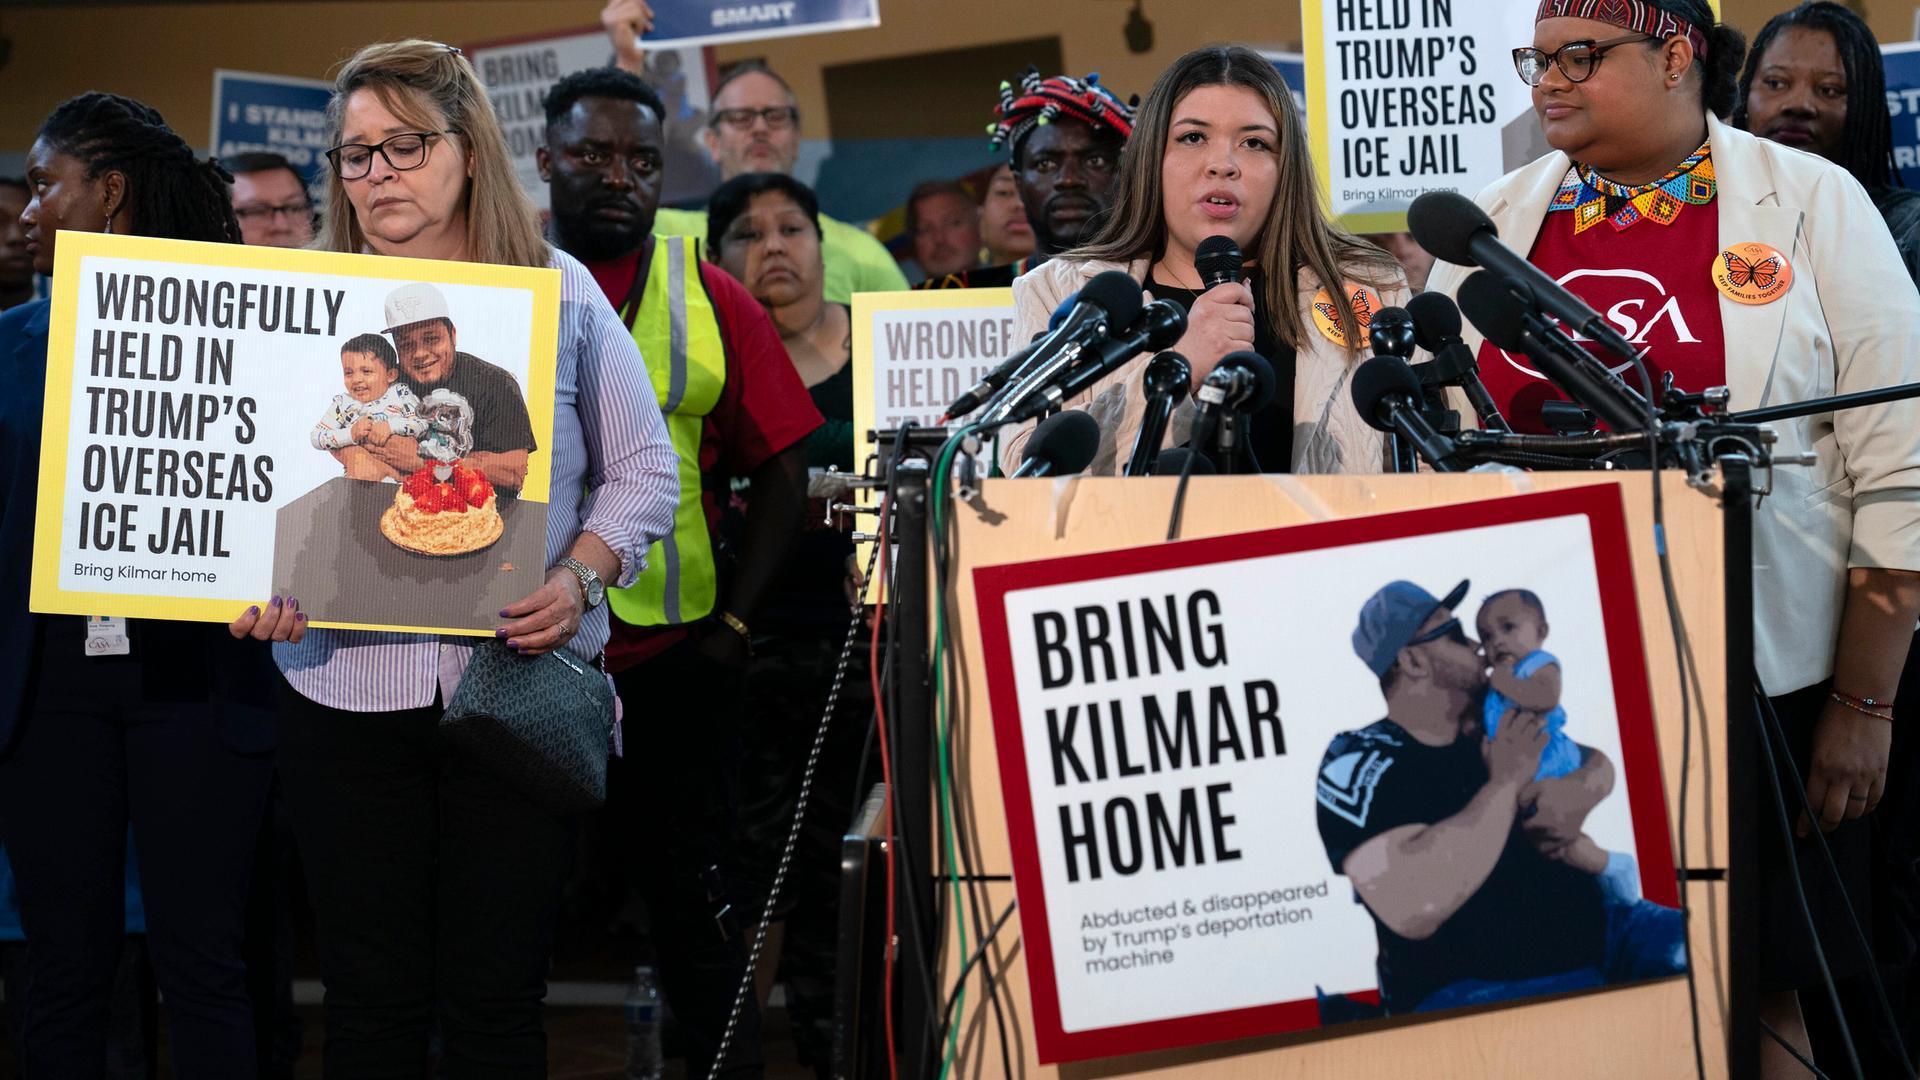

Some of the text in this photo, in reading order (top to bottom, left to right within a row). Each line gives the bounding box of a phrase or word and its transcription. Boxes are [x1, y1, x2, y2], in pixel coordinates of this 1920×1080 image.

[711, 2, 795, 27] SMART
[1336, 0, 1452, 31] HELD IN
[484, 48, 559, 87] BRING
[1336, 35, 1477, 80] TRUMP'S
[1340, 83, 1496, 129] OVERSEAS
[1343, 134, 1467, 178] ICE JAIL
[1343, 189, 1375, 203] Bring
[1378, 186, 1418, 200] Kilmar
[95, 271, 346, 337] WRONGFULLY
[1718, 274, 1786, 299] KEEP FAMILIES TOGETHER
[1326, 326, 1342, 338] KEEP
[90, 329, 234, 386] HELD IN
[887, 367, 960, 408] HELD
[86, 386, 257, 445] TRUMP'S
[82, 444, 274, 502] OVERSEAS
[79, 501, 230, 558] ICE JAIL
[74, 563, 217, 583] Bring Kilmar home
[1032, 589, 1228, 690] BRING
[1045, 679, 1287, 787] KILMAR
[1058, 782, 1242, 883] HOME
[1080, 880, 1329, 931] Abducted & disappeared
[1082, 906, 1313, 956] by Trump's deportation
[1085, 948, 1175, 975] machine
